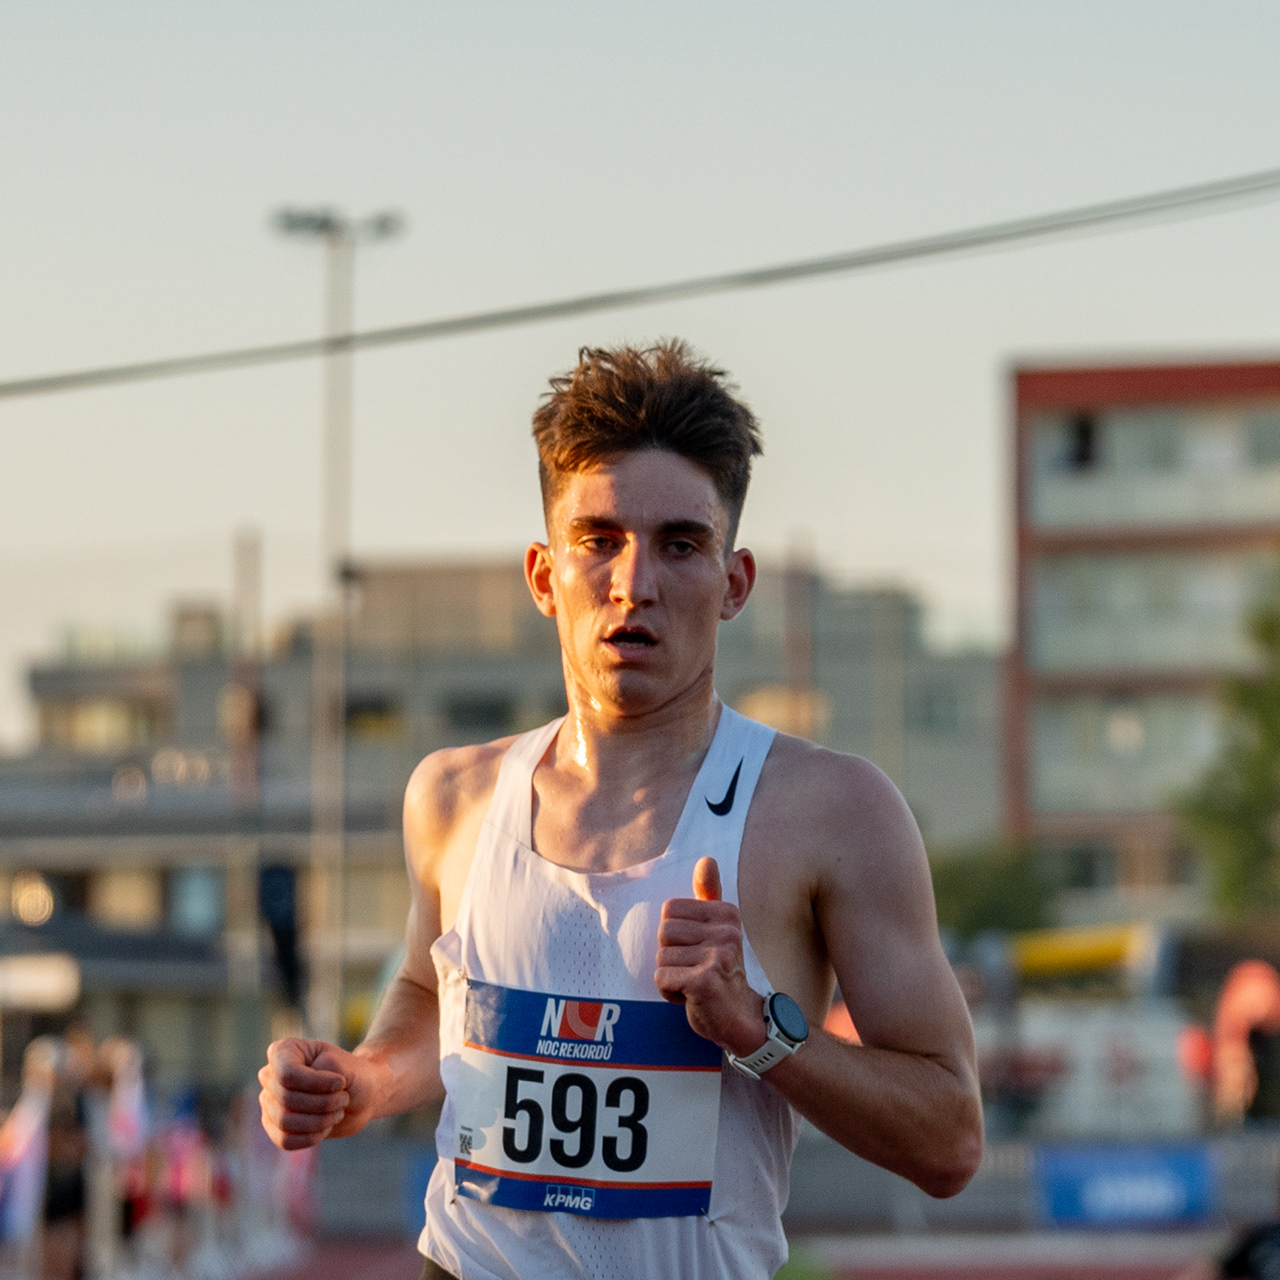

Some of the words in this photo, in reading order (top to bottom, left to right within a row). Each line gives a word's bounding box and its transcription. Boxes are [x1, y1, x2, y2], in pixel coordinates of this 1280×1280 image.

[536, 1039, 559, 1056] NOC
[559, 1042, 613, 1060] REKORDŮ
[502, 1065, 650, 1172] 593
[543, 1193, 593, 1210] KPMG
